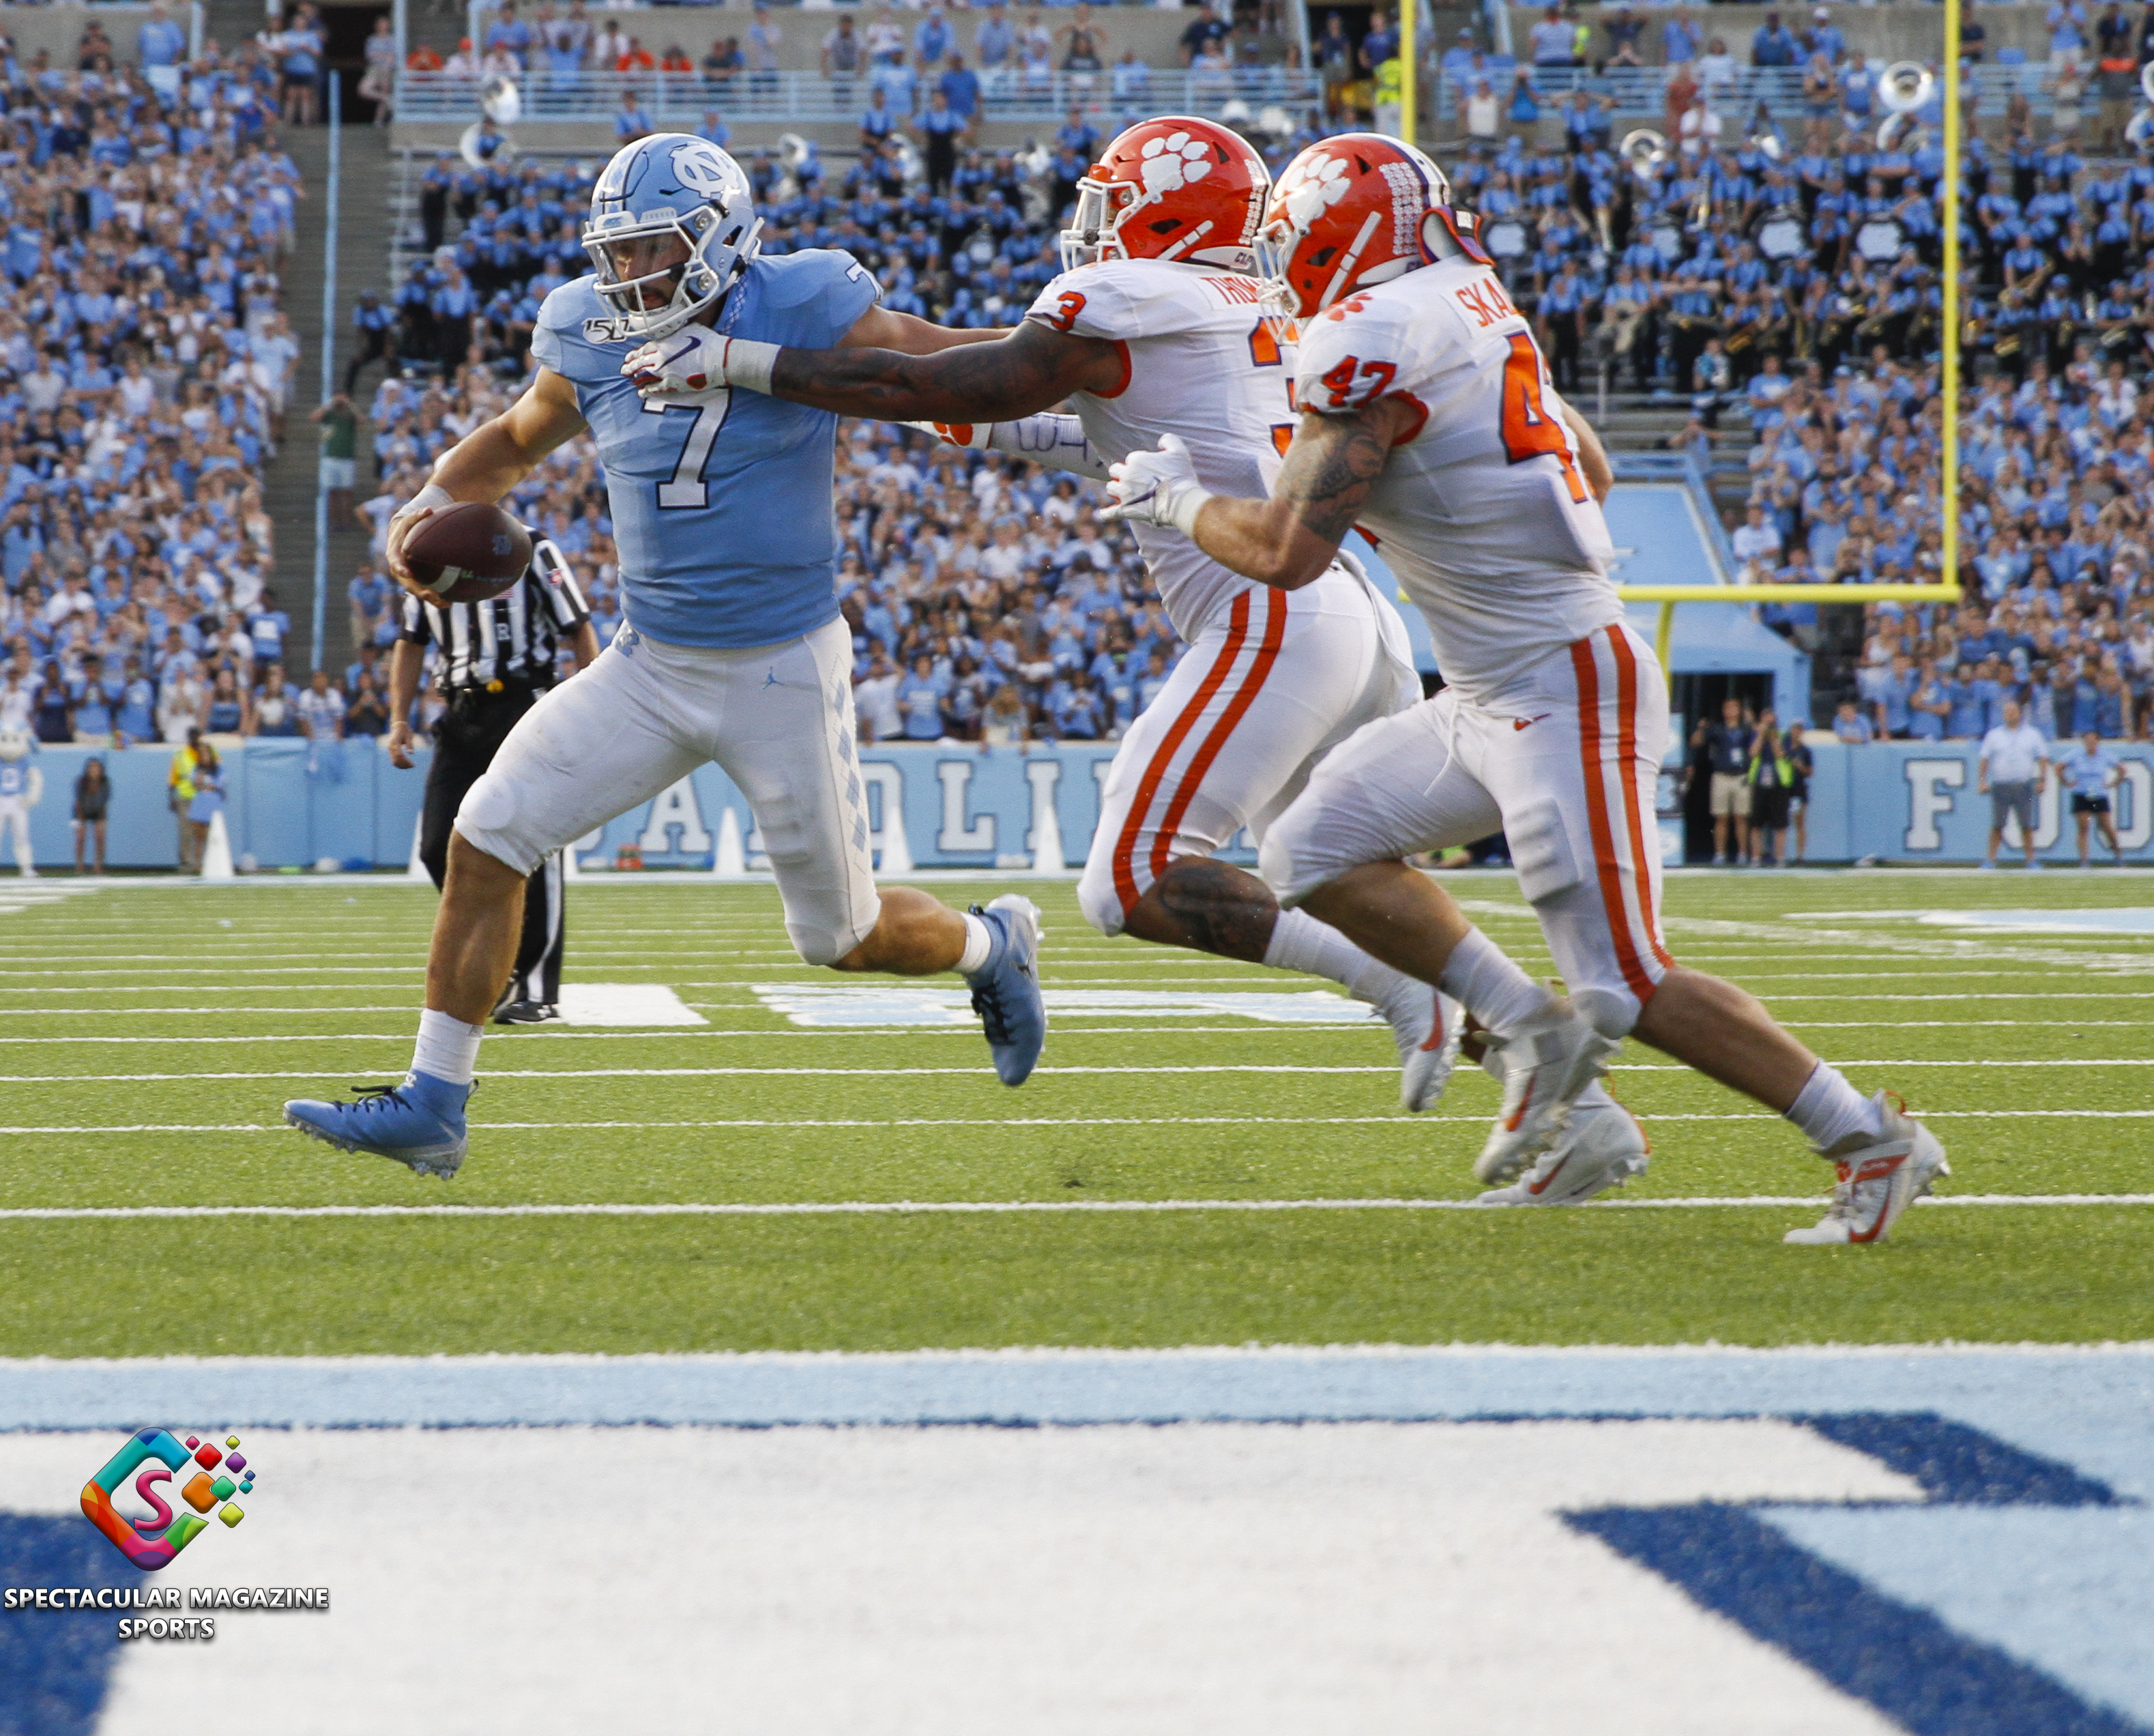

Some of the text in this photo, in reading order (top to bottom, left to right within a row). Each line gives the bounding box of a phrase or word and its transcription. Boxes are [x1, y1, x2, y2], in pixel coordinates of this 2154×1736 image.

[1051, 290, 1086, 331] 3
[1322, 355, 1397, 409] 47
[640, 385, 733, 510] 7
